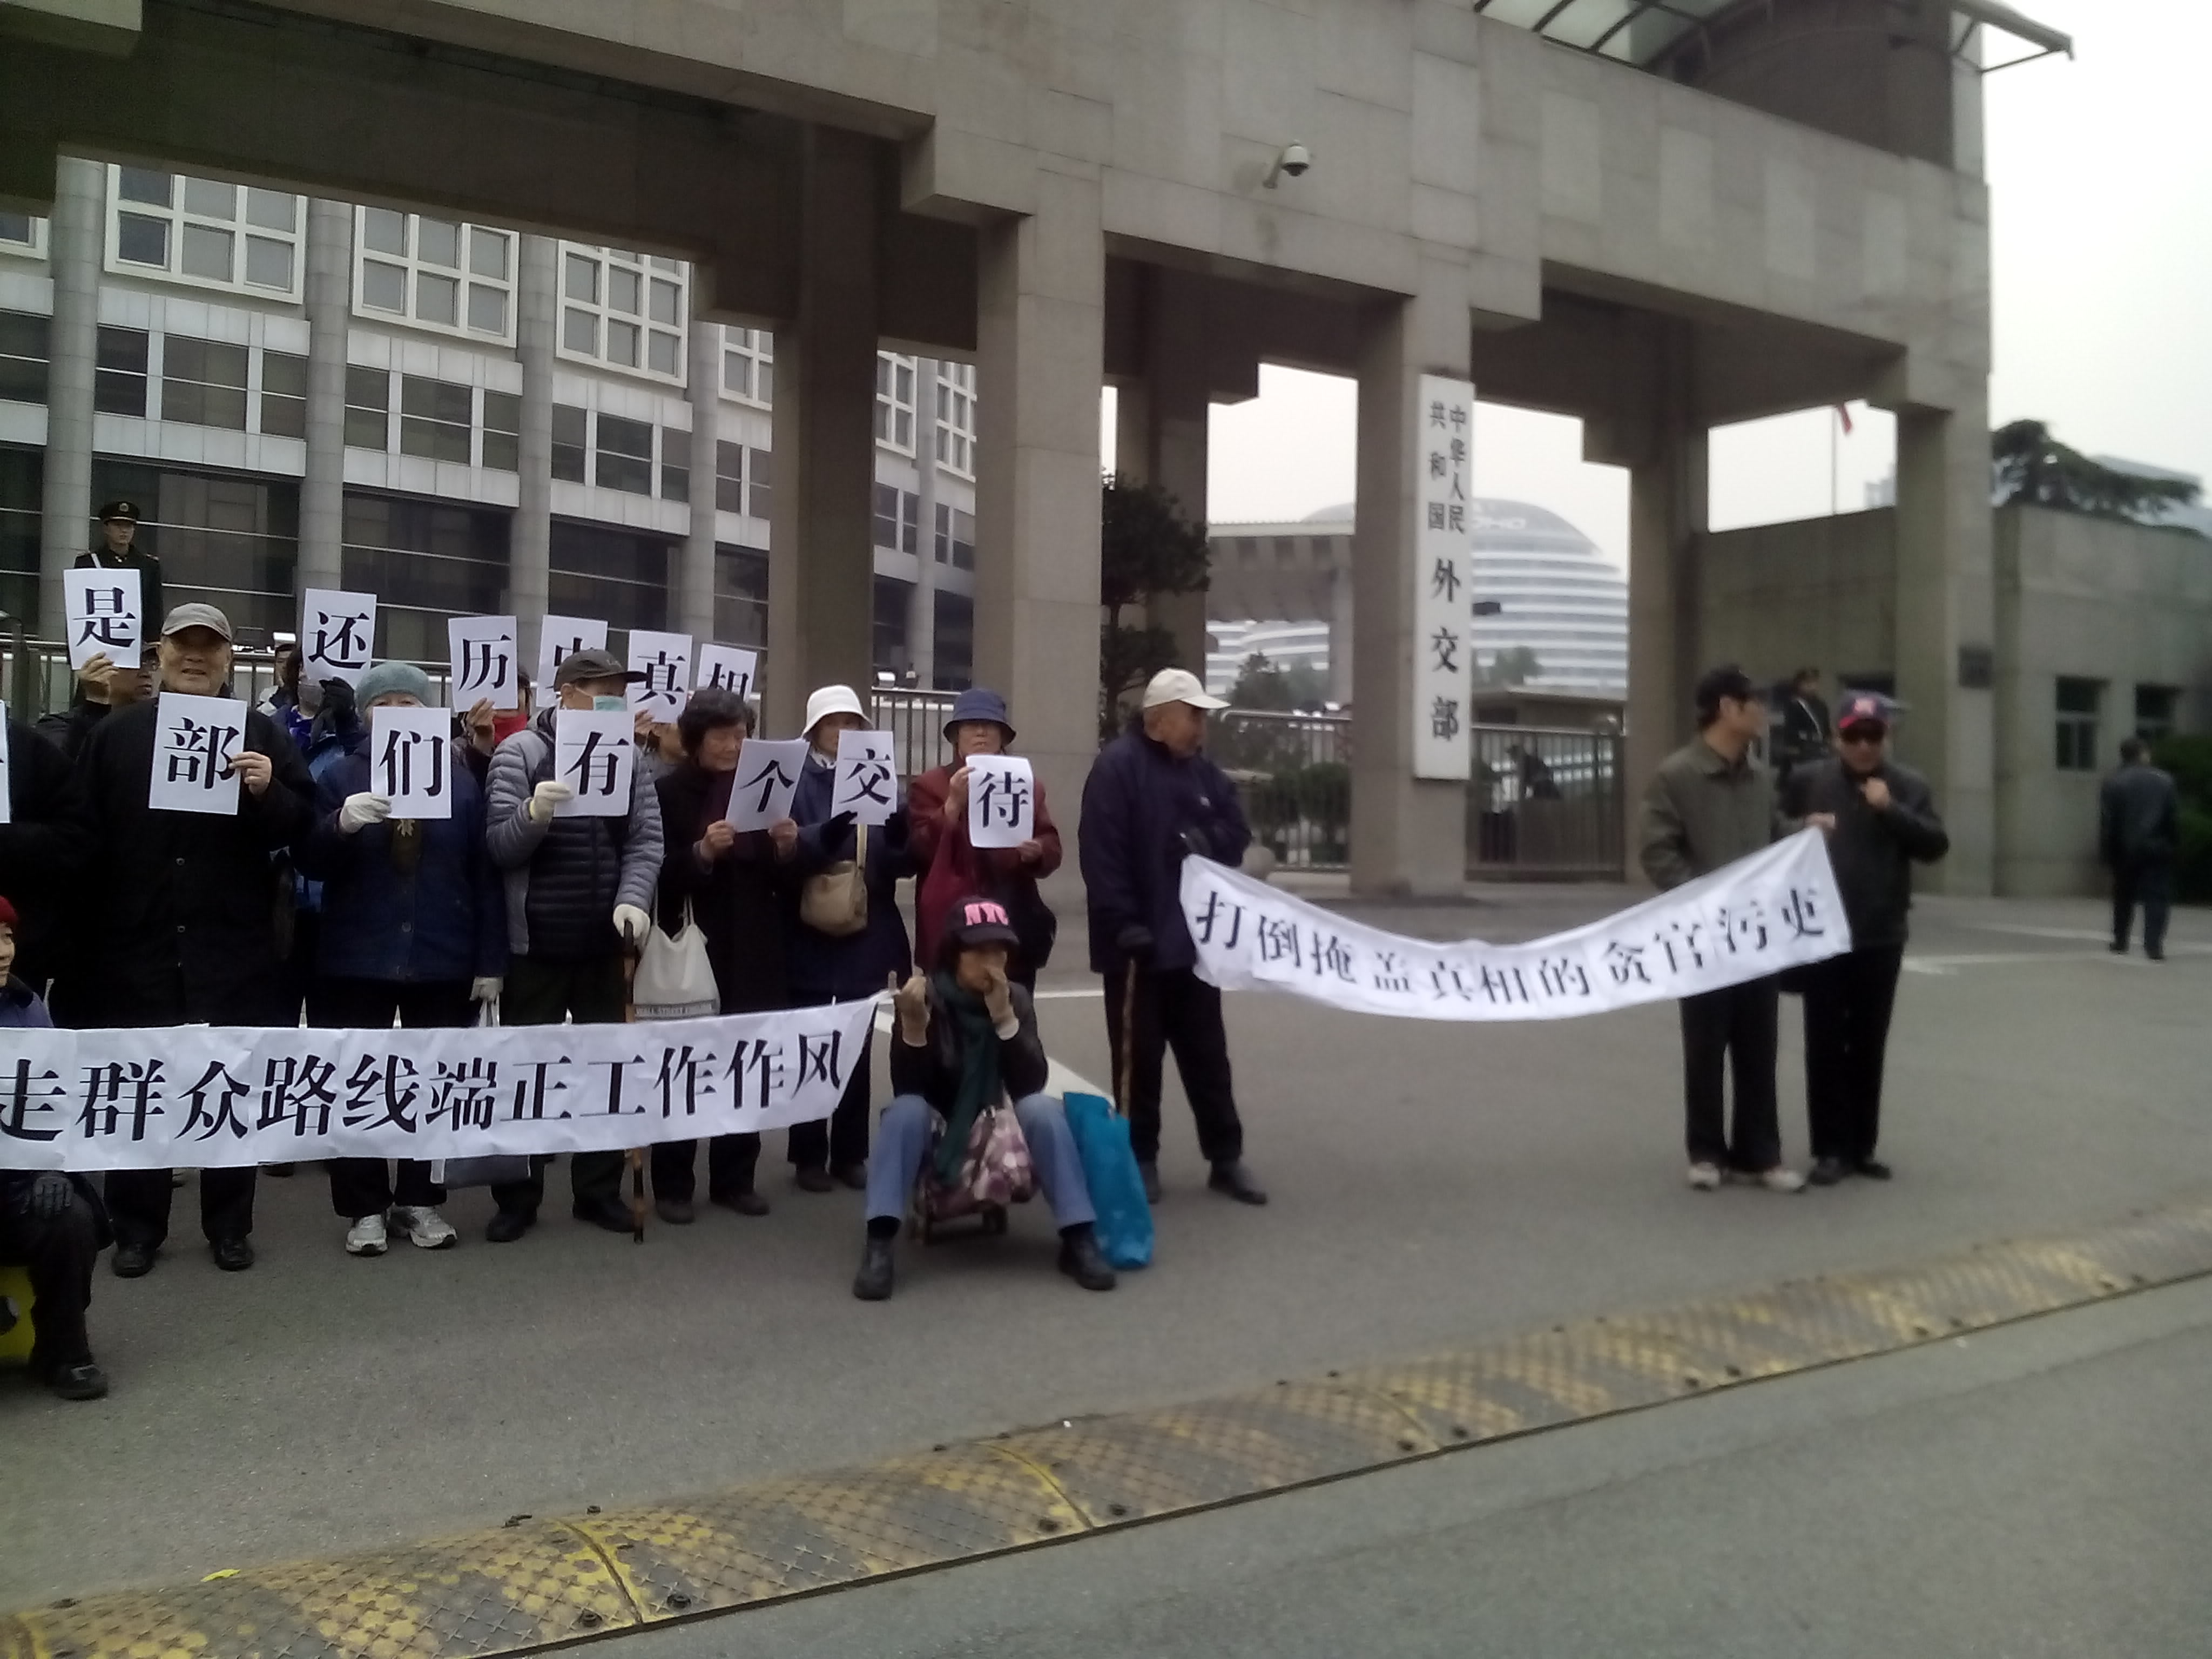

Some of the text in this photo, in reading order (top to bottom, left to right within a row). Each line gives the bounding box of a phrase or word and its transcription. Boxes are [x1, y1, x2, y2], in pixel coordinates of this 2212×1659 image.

[73, 587, 134, 648] 是
[309, 611, 369, 670] 还
[459, 634, 512, 692] 历
[637, 651, 685, 704] 真
[1431, 557, 1461, 741] 外交部
[164, 717, 240, 790] 部
[380, 730, 444, 797] 们
[563, 731, 630, 796] 有
[839, 748, 892, 805] 交
[738, 759, 794, 812] 个
[976, 771, 1029, 828] 待
[0, 1029, 842, 1142] 走群众路线端正工作作风
